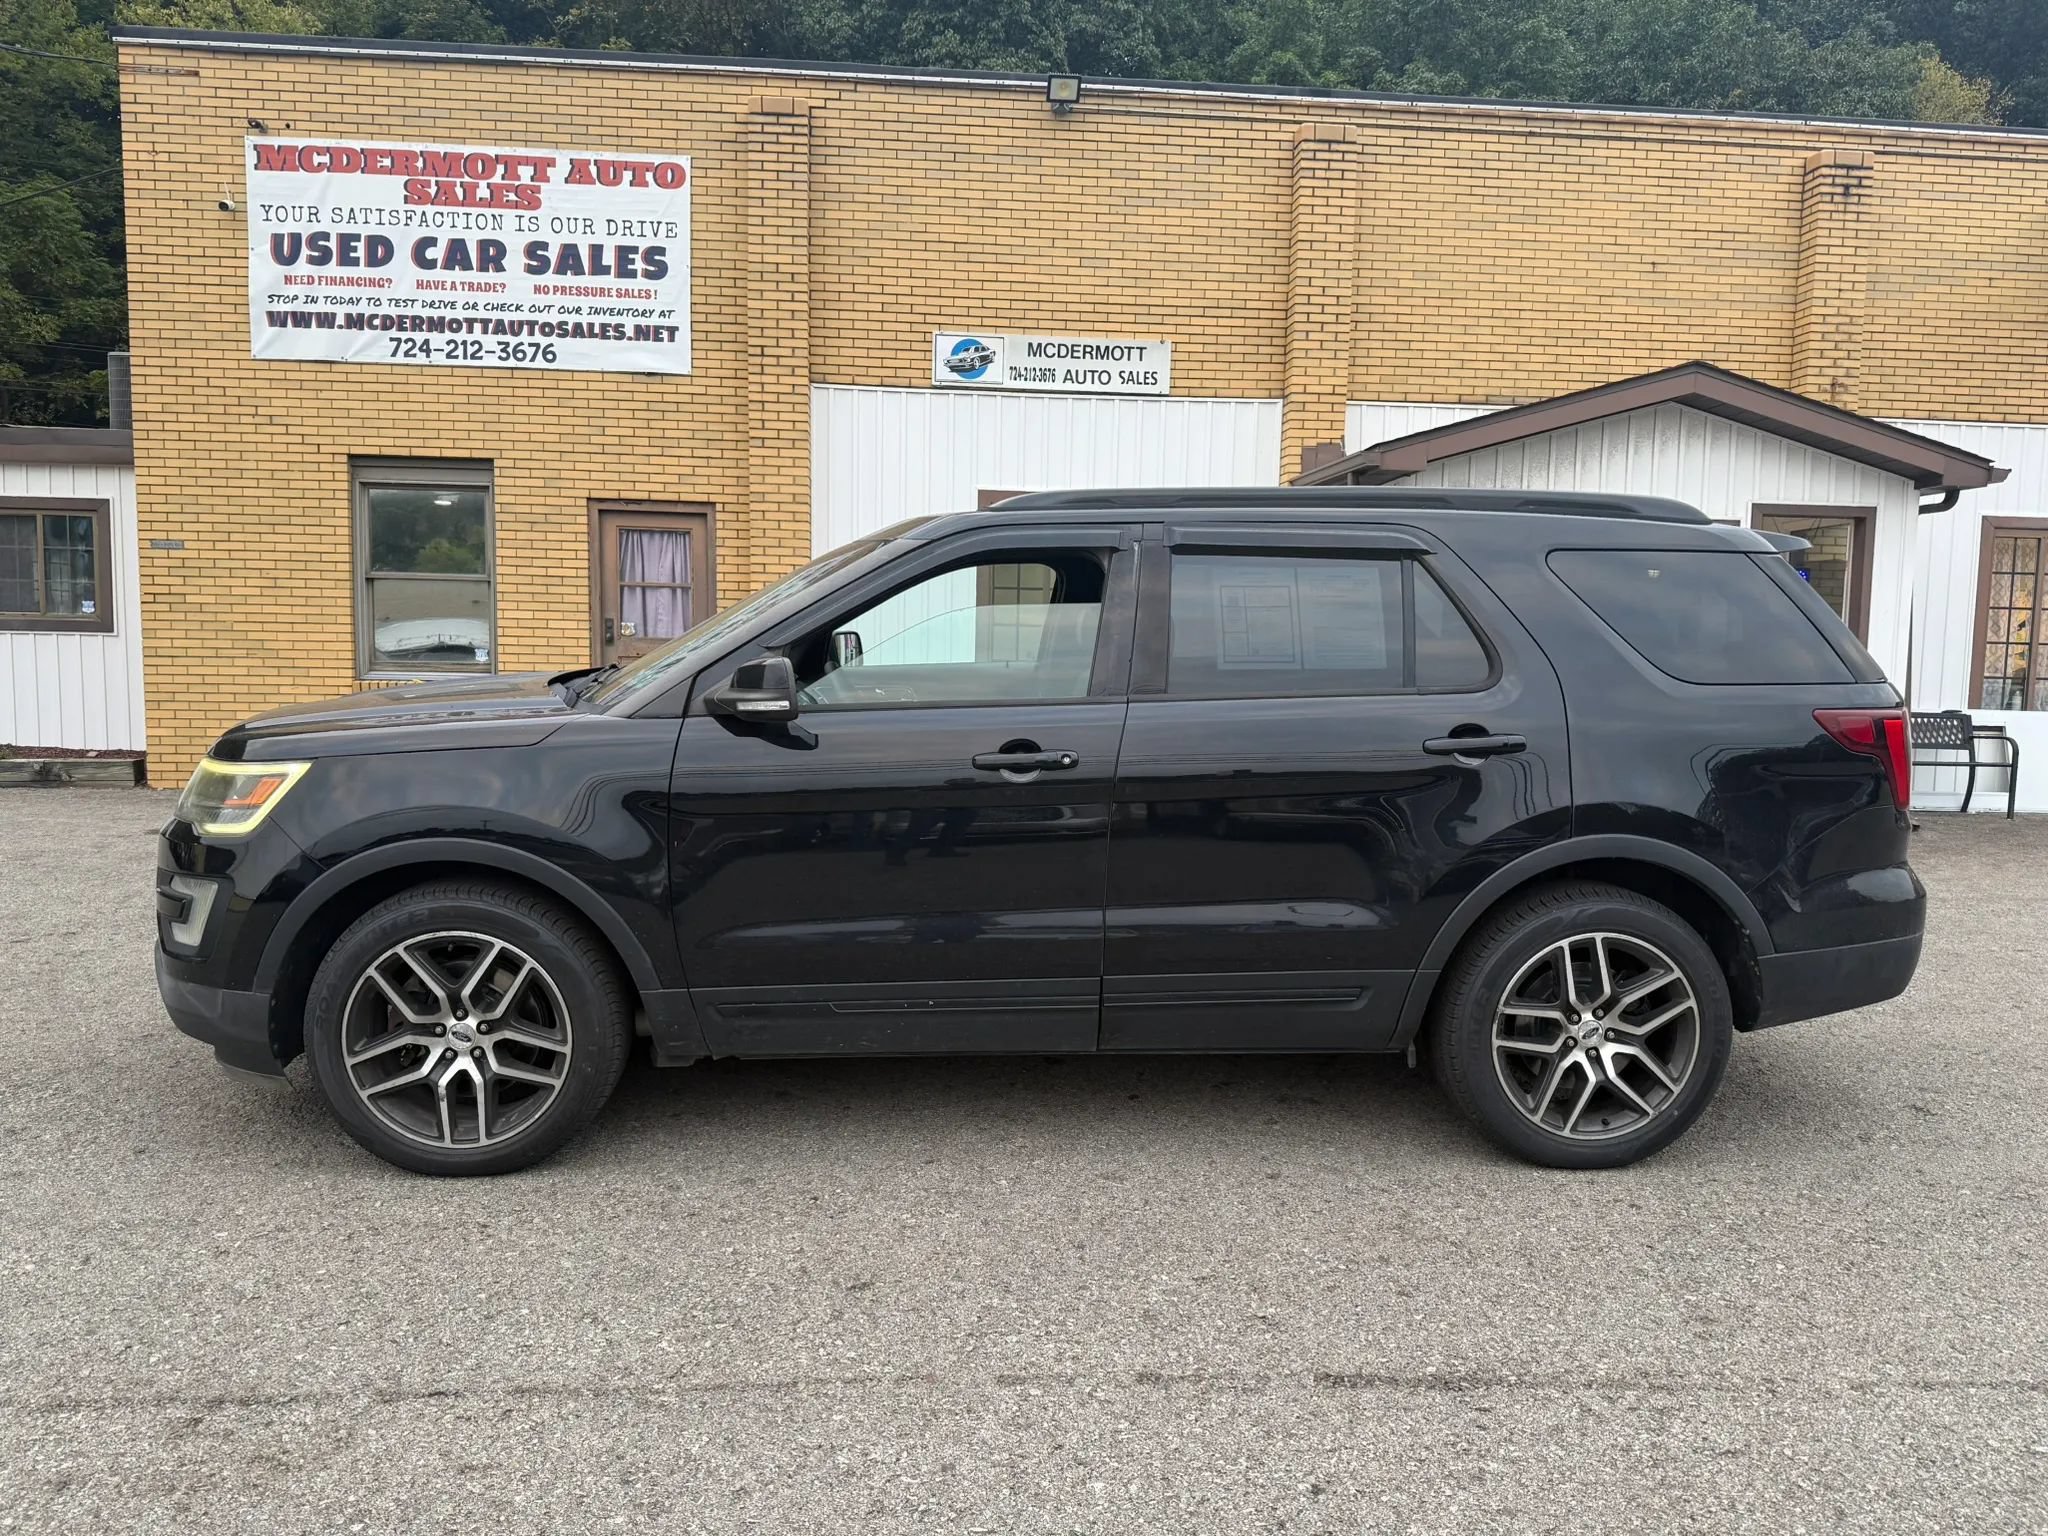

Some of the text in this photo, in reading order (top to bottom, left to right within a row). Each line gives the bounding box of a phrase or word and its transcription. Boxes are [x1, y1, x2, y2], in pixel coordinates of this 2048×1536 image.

[254, 144, 687, 189] MCDERMOTT AUTO
[403, 178, 543, 211] SALES
[260, 204, 678, 238] YOUR SATISFACTION IS OUR DRIVE
[270, 231, 669, 281] USED CAR SALES
[284, 274, 393, 288] NEED FINANCING?
[416, 279, 507, 293] HAVE A TRADE?
[533, 284, 550, 296] NO
[552, 285, 614, 298] PRESSURE
[267, 294, 675, 319] STOP IN TODAY TO TEST DRIVE OR CHECK OUT OUR INVENTORY AT
[265, 310, 680, 343] WWW.MCDERMOTTAUTOSALES.NET
[388, 337, 558, 364] 724-212-3676
[1027, 342, 1148, 362] MCDERMOTT
[1009, 366, 1159, 386] 724-212-3676 AUTO SALES
